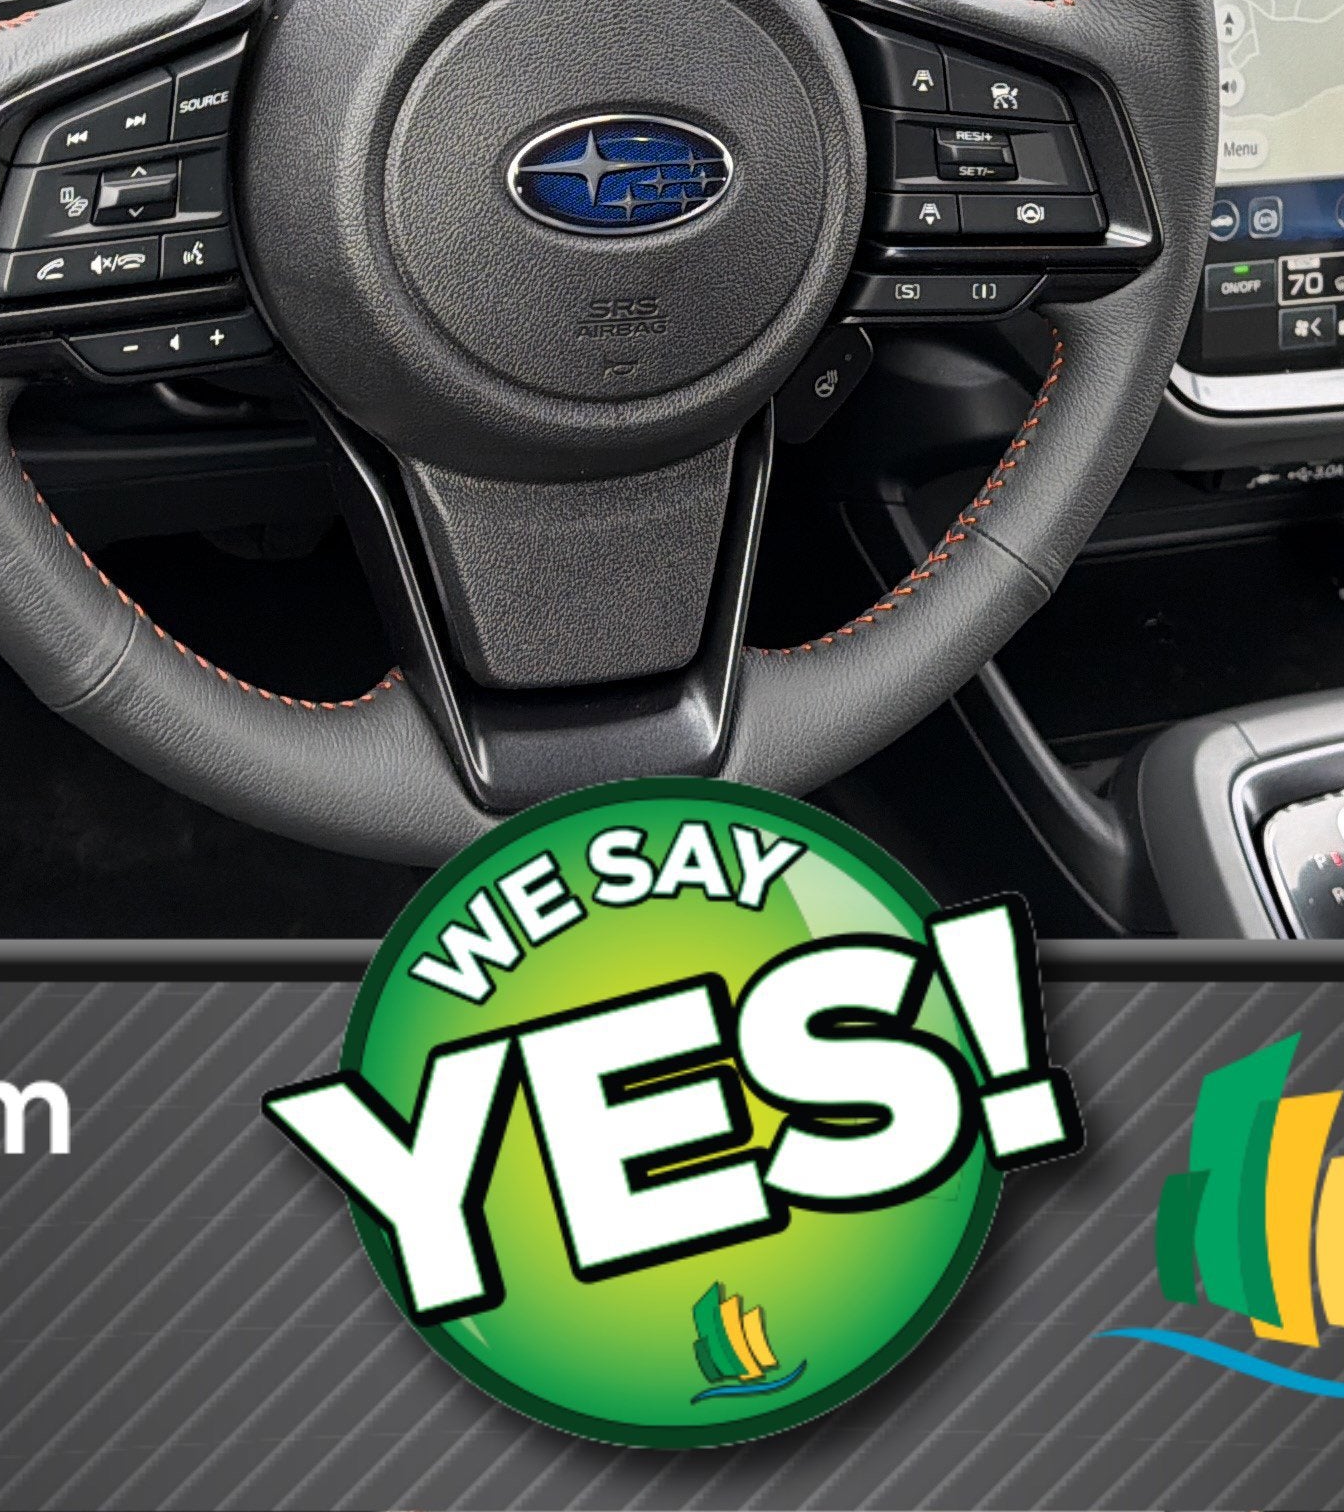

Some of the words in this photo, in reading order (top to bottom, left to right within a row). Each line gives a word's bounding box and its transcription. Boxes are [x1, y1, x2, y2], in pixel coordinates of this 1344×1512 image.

[179, 90, 230, 114] SOURCE
[1223, 141, 1258, 158] Menu
[1220, 279, 1262, 295] ON/OFF
[1288, 272, 1324, 296] 70
[588, 297, 661, 319] SRS
[578, 323, 668, 339] AIRBAG
